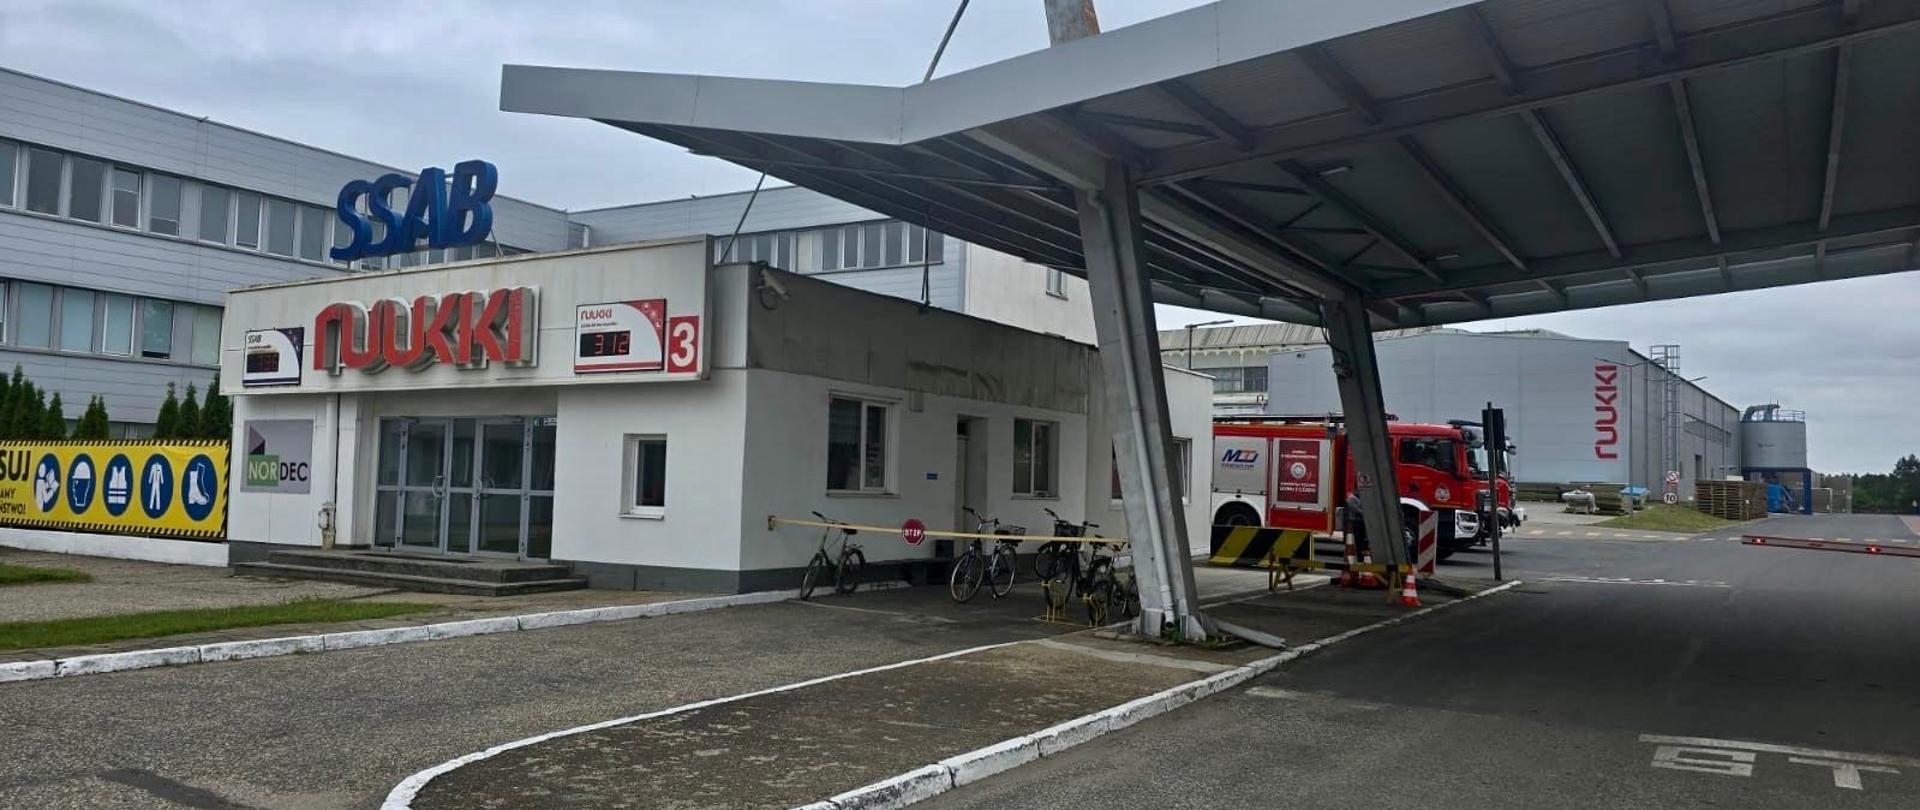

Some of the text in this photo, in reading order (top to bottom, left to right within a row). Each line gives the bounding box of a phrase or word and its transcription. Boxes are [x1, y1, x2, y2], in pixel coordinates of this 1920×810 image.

[330, 160, 498, 261] SSAB
[595, 334, 629, 354] 312
[671, 321, 695, 367] 3
[0, 450, 31, 481] SUJ
[249, 461, 308, 482] NORDEC
[1666, 494, 1676, 502] 10
[904, 528, 921, 537] STOP
